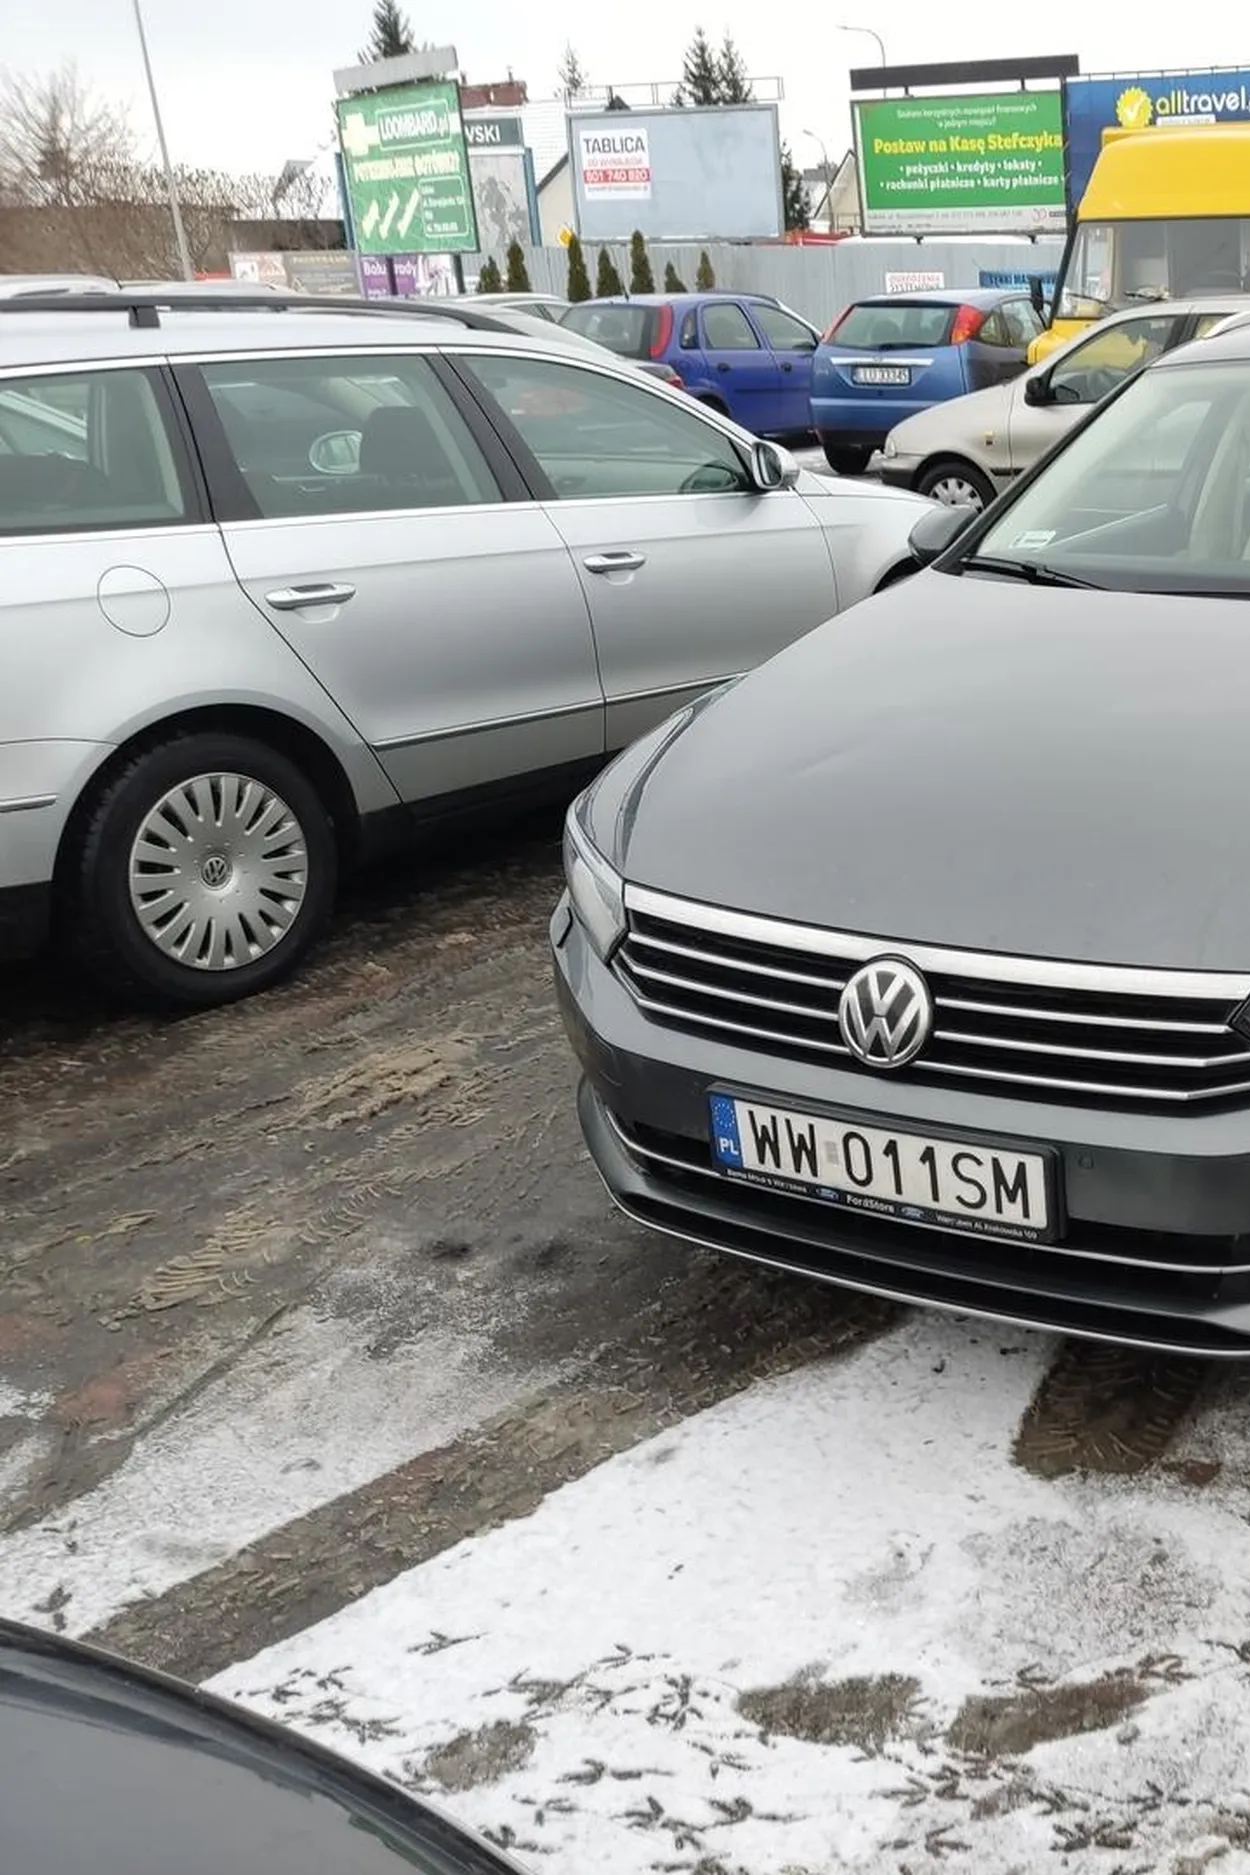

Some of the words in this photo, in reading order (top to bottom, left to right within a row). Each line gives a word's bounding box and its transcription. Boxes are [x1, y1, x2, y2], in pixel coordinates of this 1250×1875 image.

[583, 136, 645, 153] TABLICA
[873, 138, 925, 154] Postaw
[929, 142, 947, 152] na
[949, 136, 986, 154] Kasę
[987, 132, 1063, 153] Stefczyka
[956, 161, 996, 175] kredyty
[1003, 160, 1036, 172] lokaty
[983, 176, 1010, 189] karty
[719, 1137, 740, 1156] PL
[748, 1110, 818, 1178] WW
[842, 1131, 1030, 1220] 011SM
